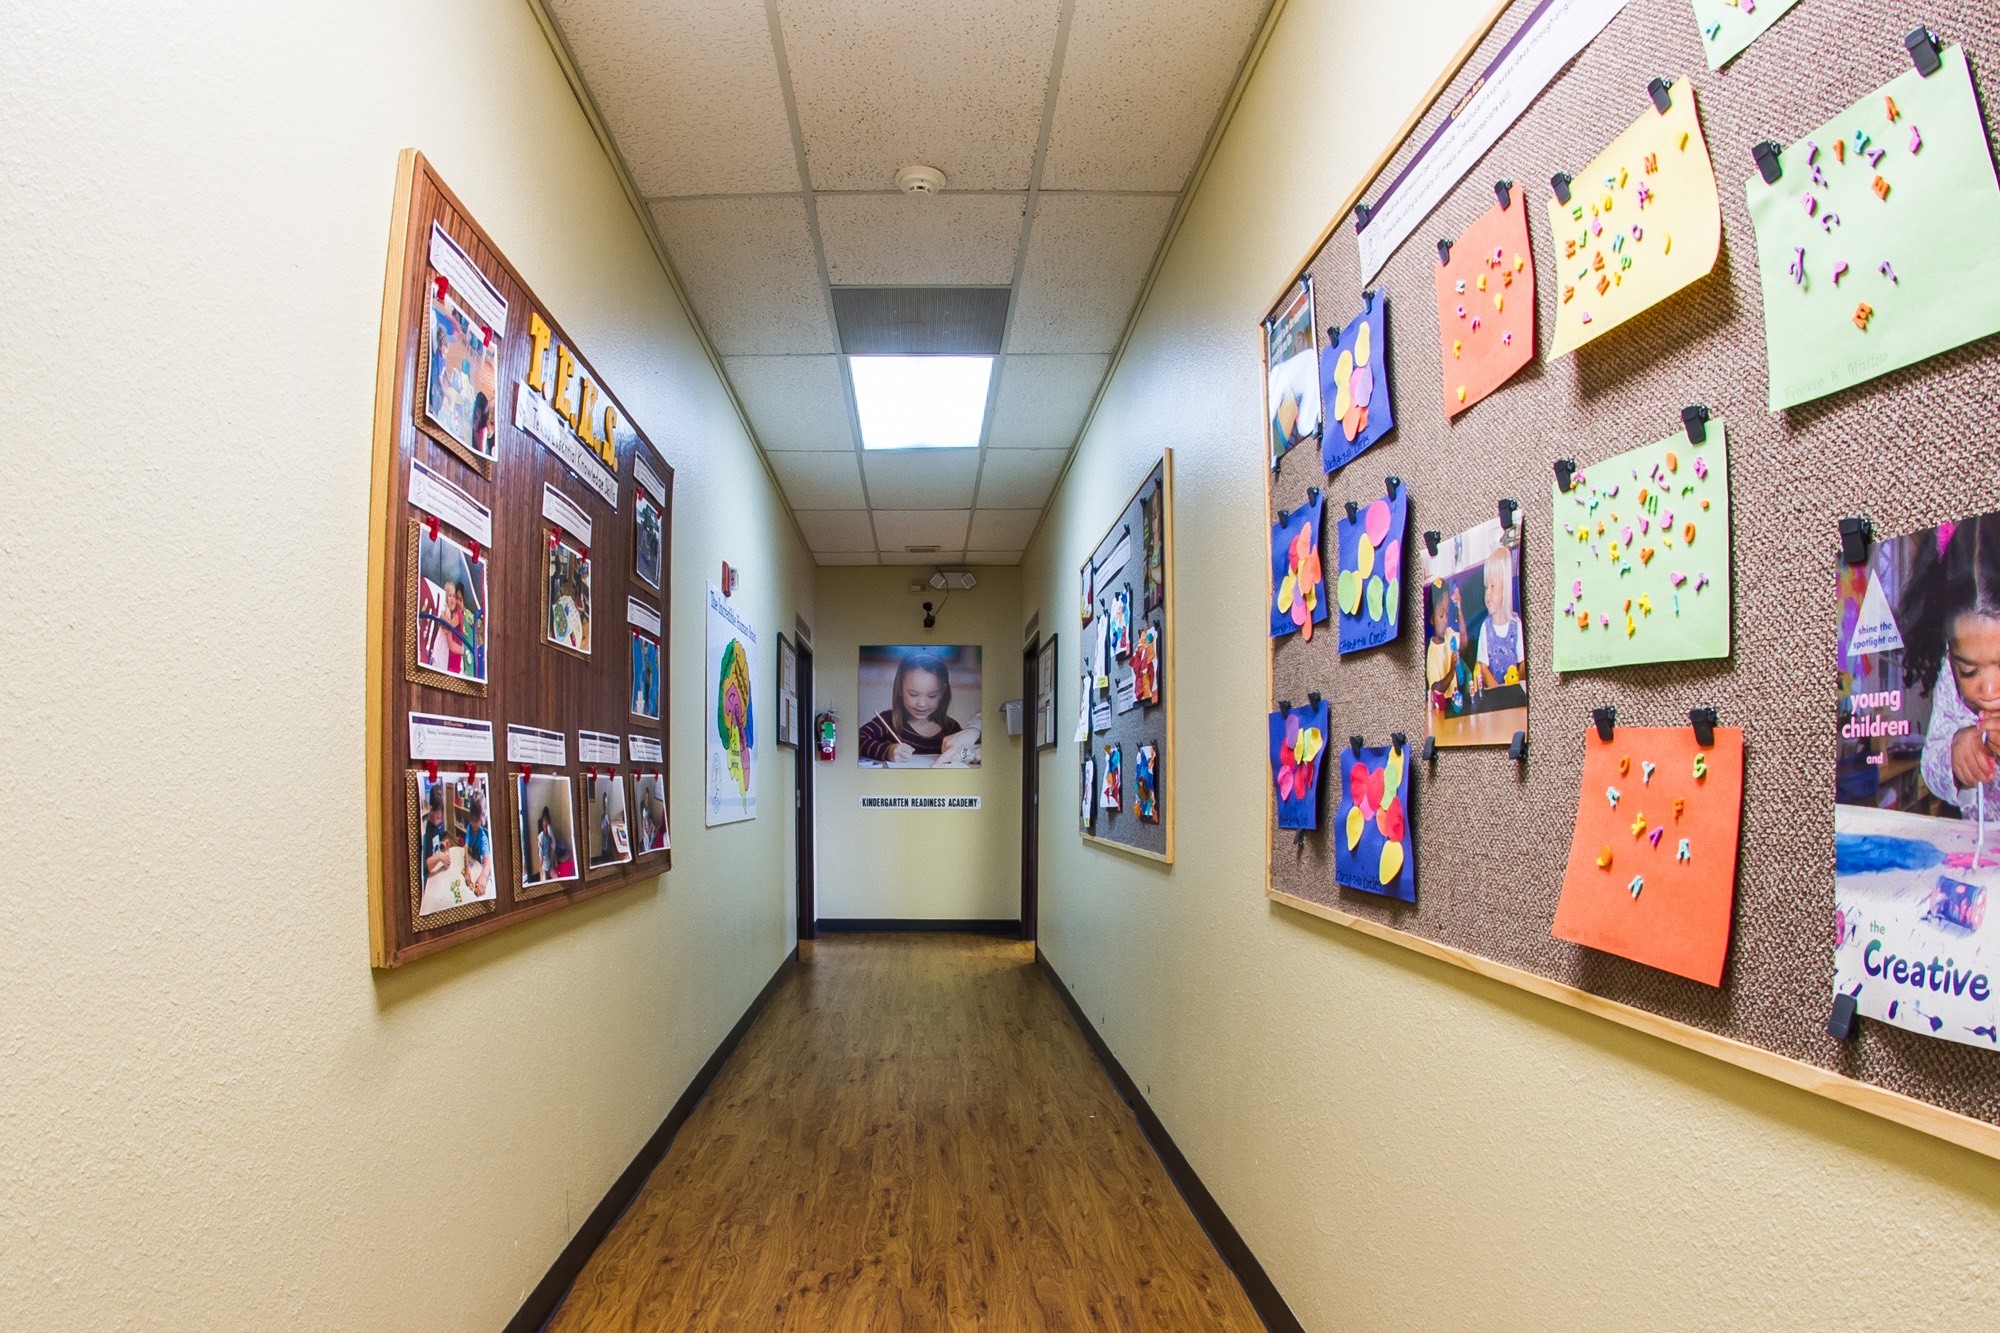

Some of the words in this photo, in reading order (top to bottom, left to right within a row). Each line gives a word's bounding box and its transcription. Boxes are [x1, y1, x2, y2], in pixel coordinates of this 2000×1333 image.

[1451, 91, 1473, 120] Creative
[1471, 77, 1485, 96] Arts
[578, 452, 604, 492] Knowledge
[604, 477, 616, 503] Skills
[718, 597, 736, 627] Incredible
[736, 614, 749, 637] Human
[1858, 624, 1878, 635] shine
[1880, 621, 1893, 632] the
[1853, 635, 1886, 650] spotlight
[1887, 634, 1898, 644] on
[1850, 689, 1902, 714] young
[1842, 716, 1910, 740] children
[1866, 752, 1884, 765] and
[862, 797, 909, 807] KINDERGARTEN
[911, 797, 946, 807] READINESS
[948, 797, 978, 807] ACADEMY
[1869, 920, 1886, 935] the
[1863, 939, 1991, 1002] Creative
